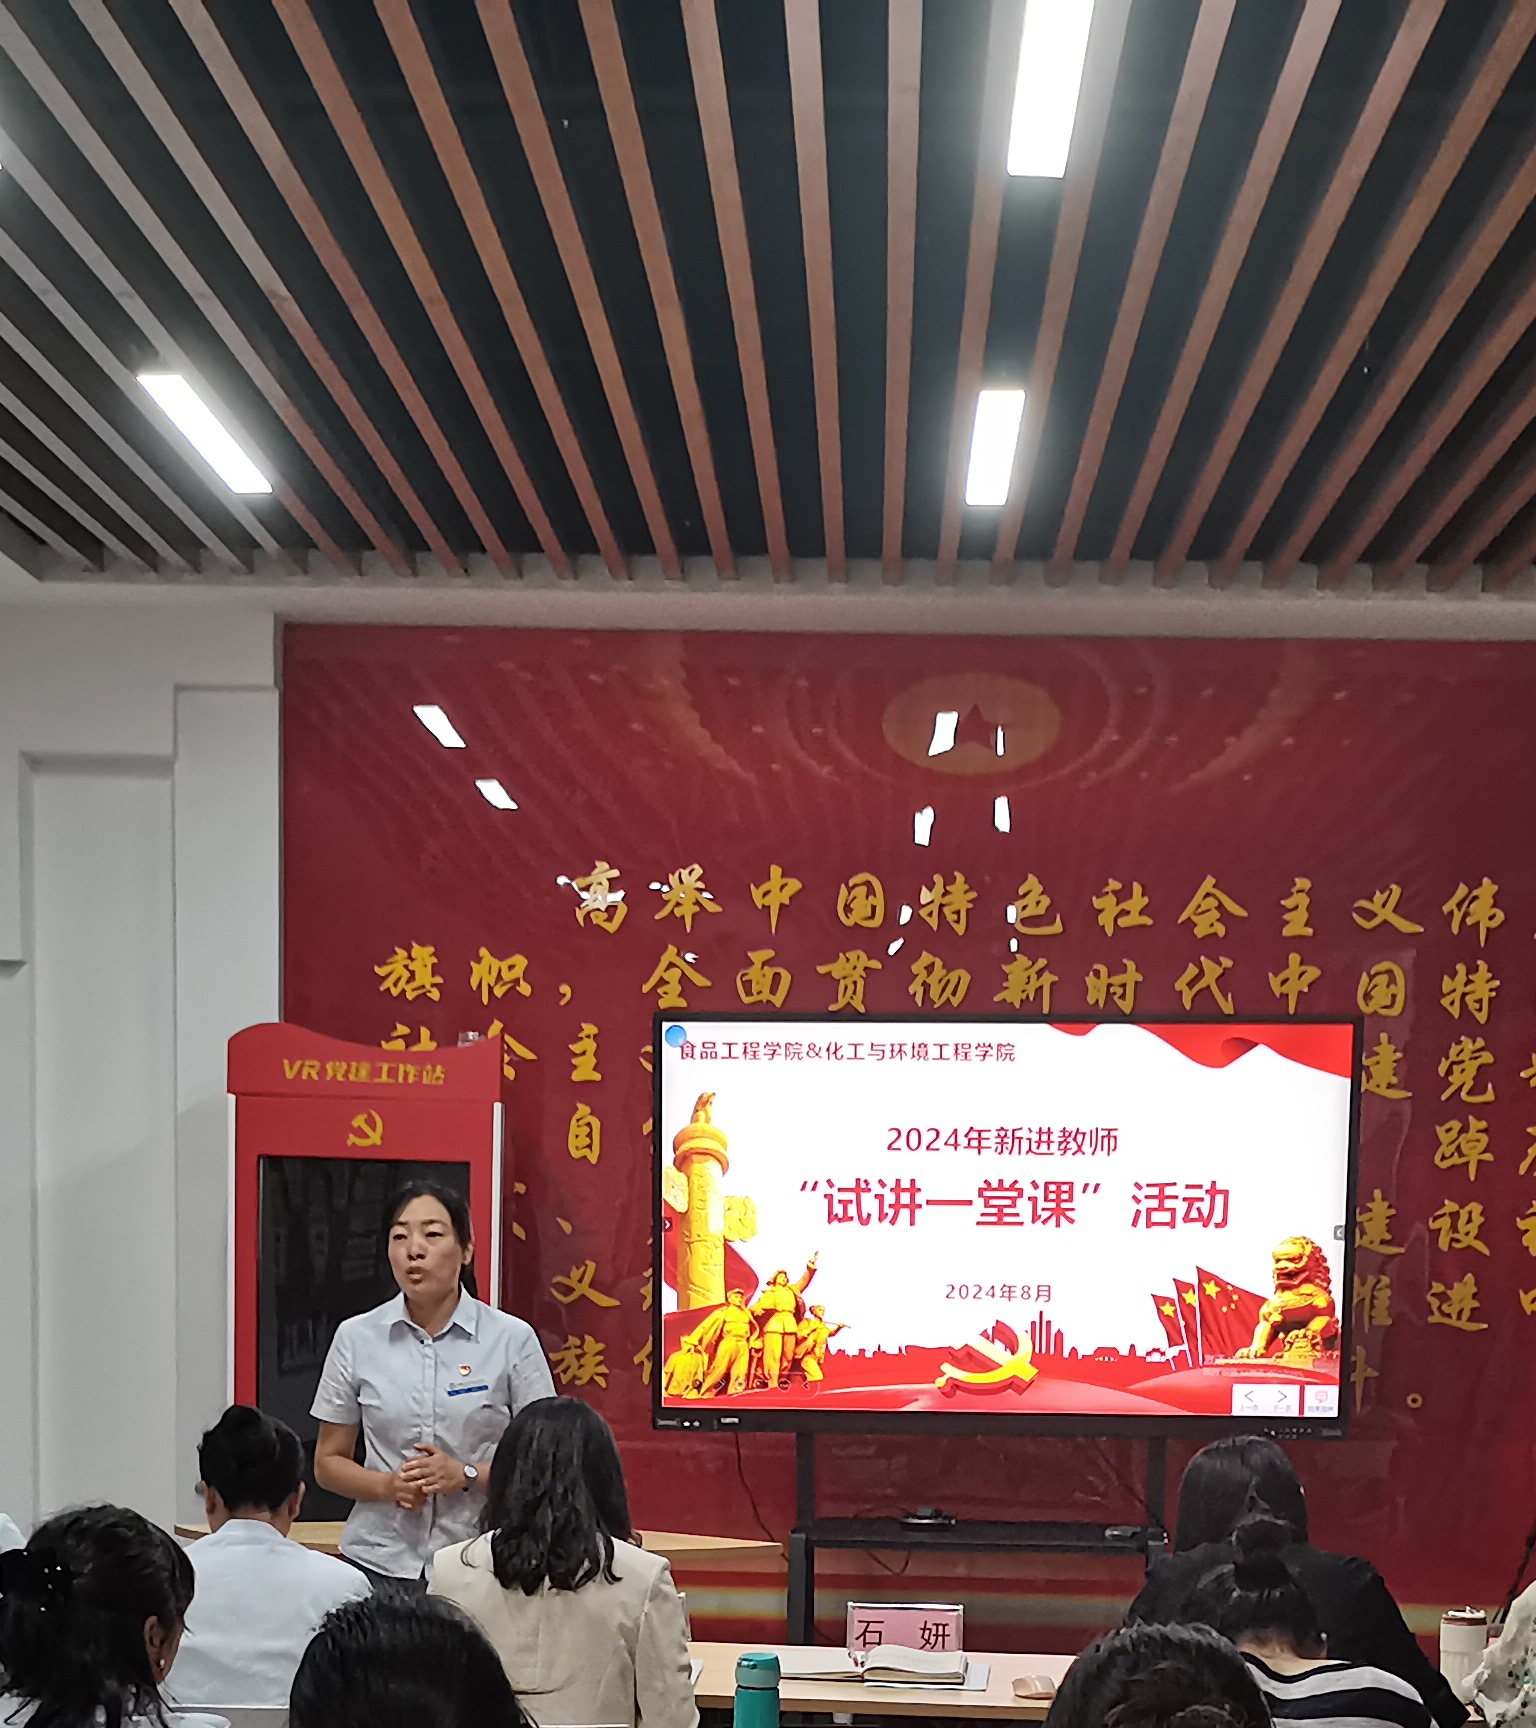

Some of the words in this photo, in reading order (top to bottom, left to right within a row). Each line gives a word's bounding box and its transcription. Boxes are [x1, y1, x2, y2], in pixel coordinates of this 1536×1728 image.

[680, 1040, 1016, 1062] 食品工程学院&化工与环境工程学院
[886, 1125, 1119, 1157] 2024年新进教师
[945, 1283, 1053, 1303] 2024年8月
[855, 1619, 885, 1648] 石
[919, 1619, 951, 1650] 妍
